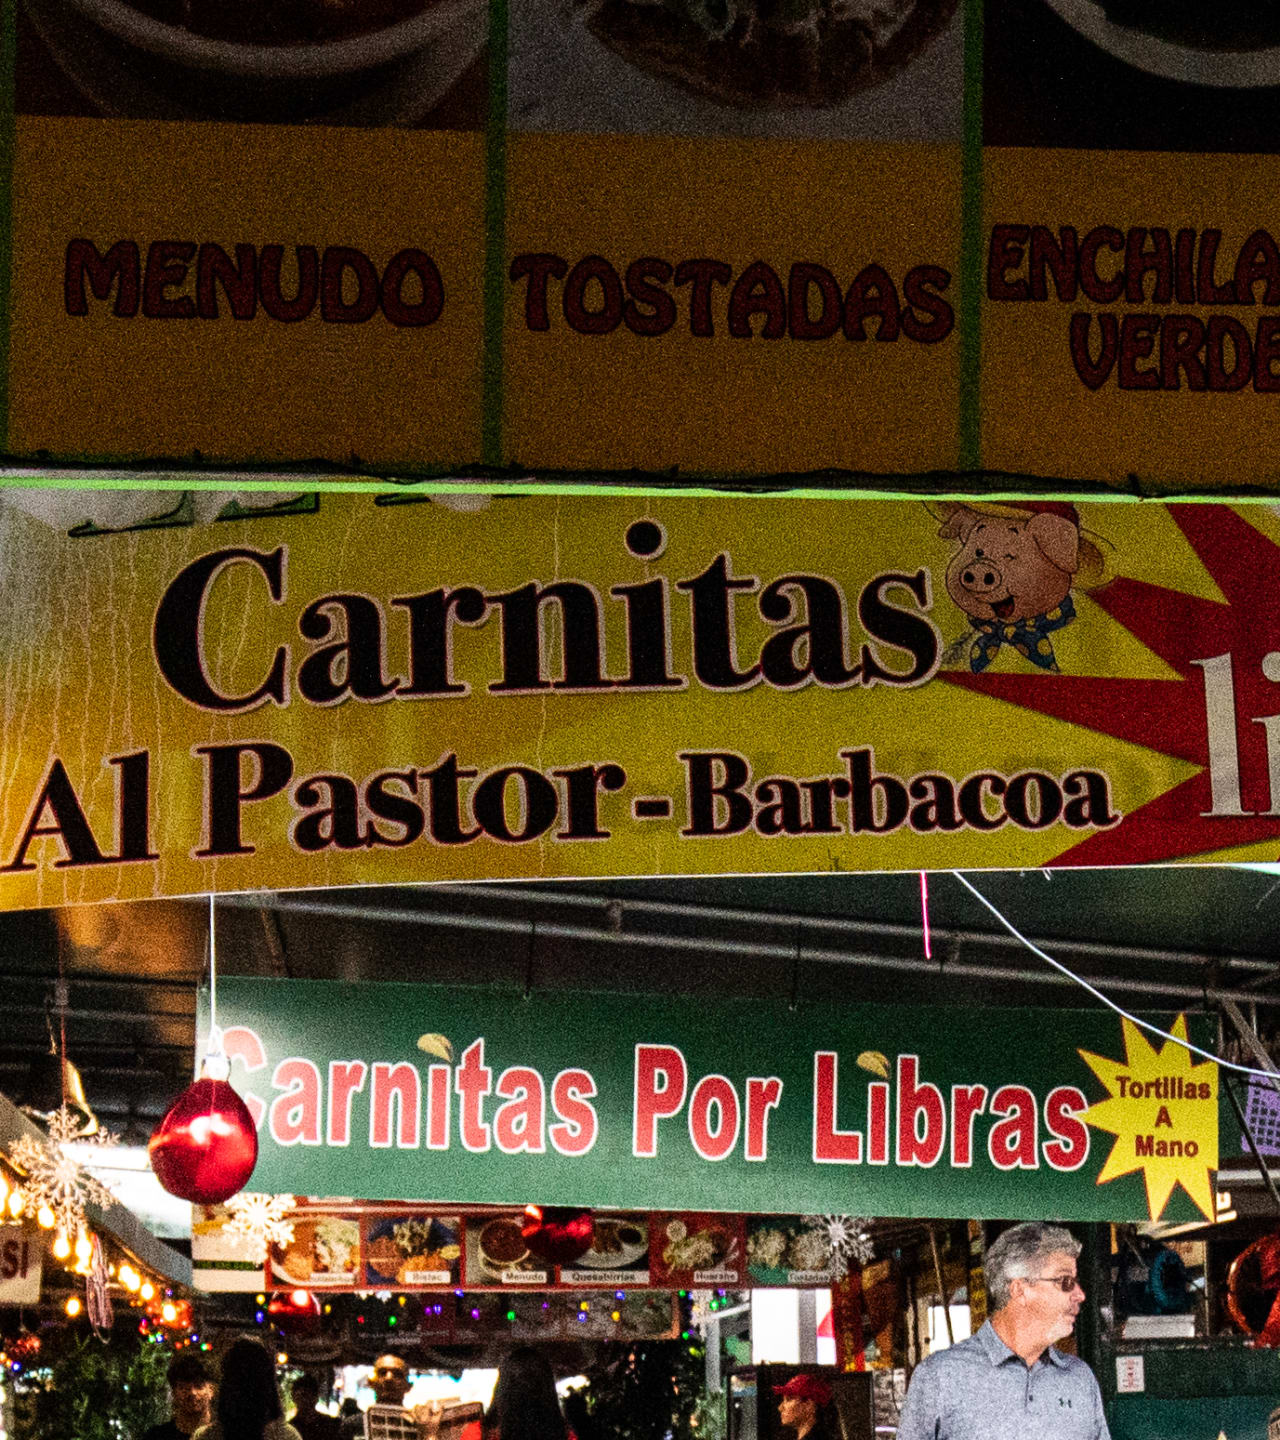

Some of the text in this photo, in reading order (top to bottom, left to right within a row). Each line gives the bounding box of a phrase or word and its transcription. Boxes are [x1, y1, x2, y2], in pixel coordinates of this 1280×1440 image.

[64, 237, 446, 328] MENUDO
[510, 253, 955, 344] TOSTADAS
[150, 518, 941, 713] Carnitas
[0, 748, 160, 873] Al
[631, 1043, 782, 1162] Por
[812, 1049, 1090, 1172] Libras
[1116, 1075, 1211, 1102] Tortillas
[1155, 1106, 1173, 1129] A
[1134, 1135, 1200, 1159] Mano
